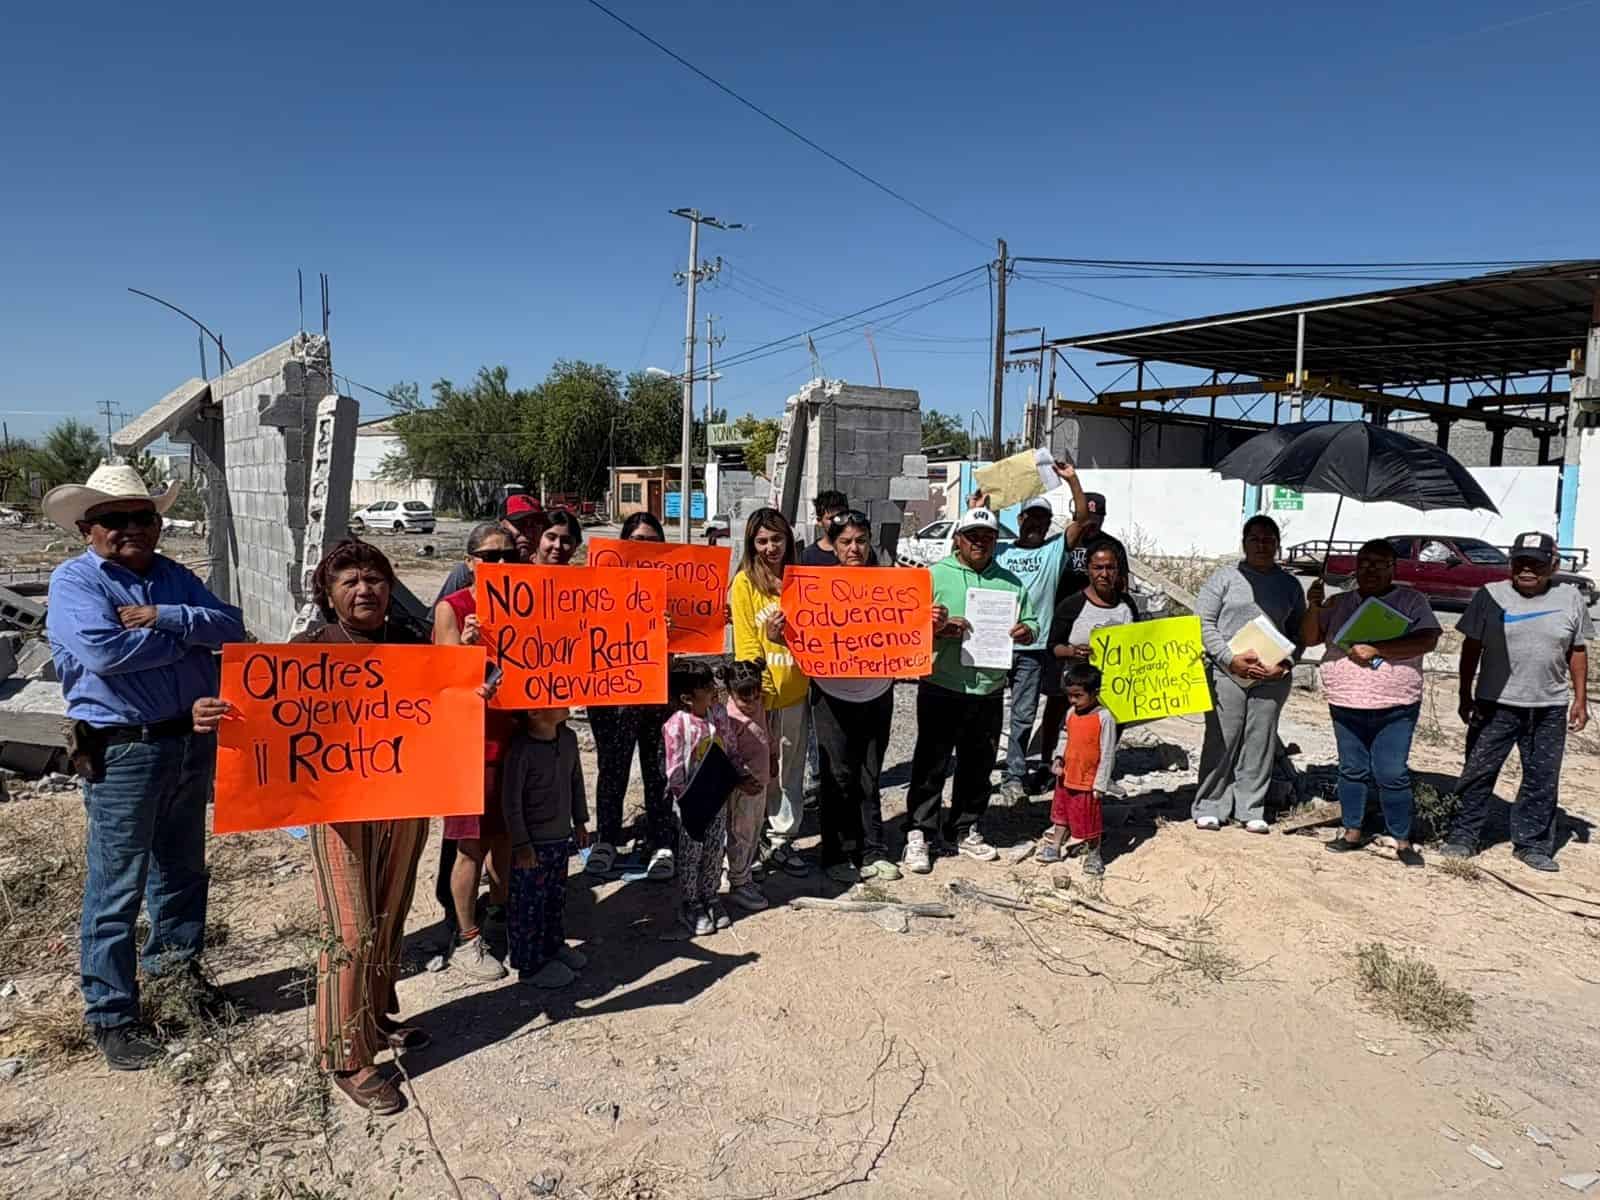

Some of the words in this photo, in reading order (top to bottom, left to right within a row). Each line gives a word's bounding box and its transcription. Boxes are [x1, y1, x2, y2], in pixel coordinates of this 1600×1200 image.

[1009, 564, 1041, 573] BLACK
[543, 578, 615, 620] llenas
[627, 580, 653, 613] de
[786, 574, 822, 605] Te
[831, 578, 920, 610] Quieres
[496, 624, 581, 672] Robar
[792, 630, 824, 654] de
[830, 630, 921, 660] terrenos
[1096, 635, 1121, 671] Ya
[1130, 641, 1157, 662] no
[829, 659, 848, 675] no
[271, 689, 432, 732] oyervides
[289, 727, 404, 783] Rata
